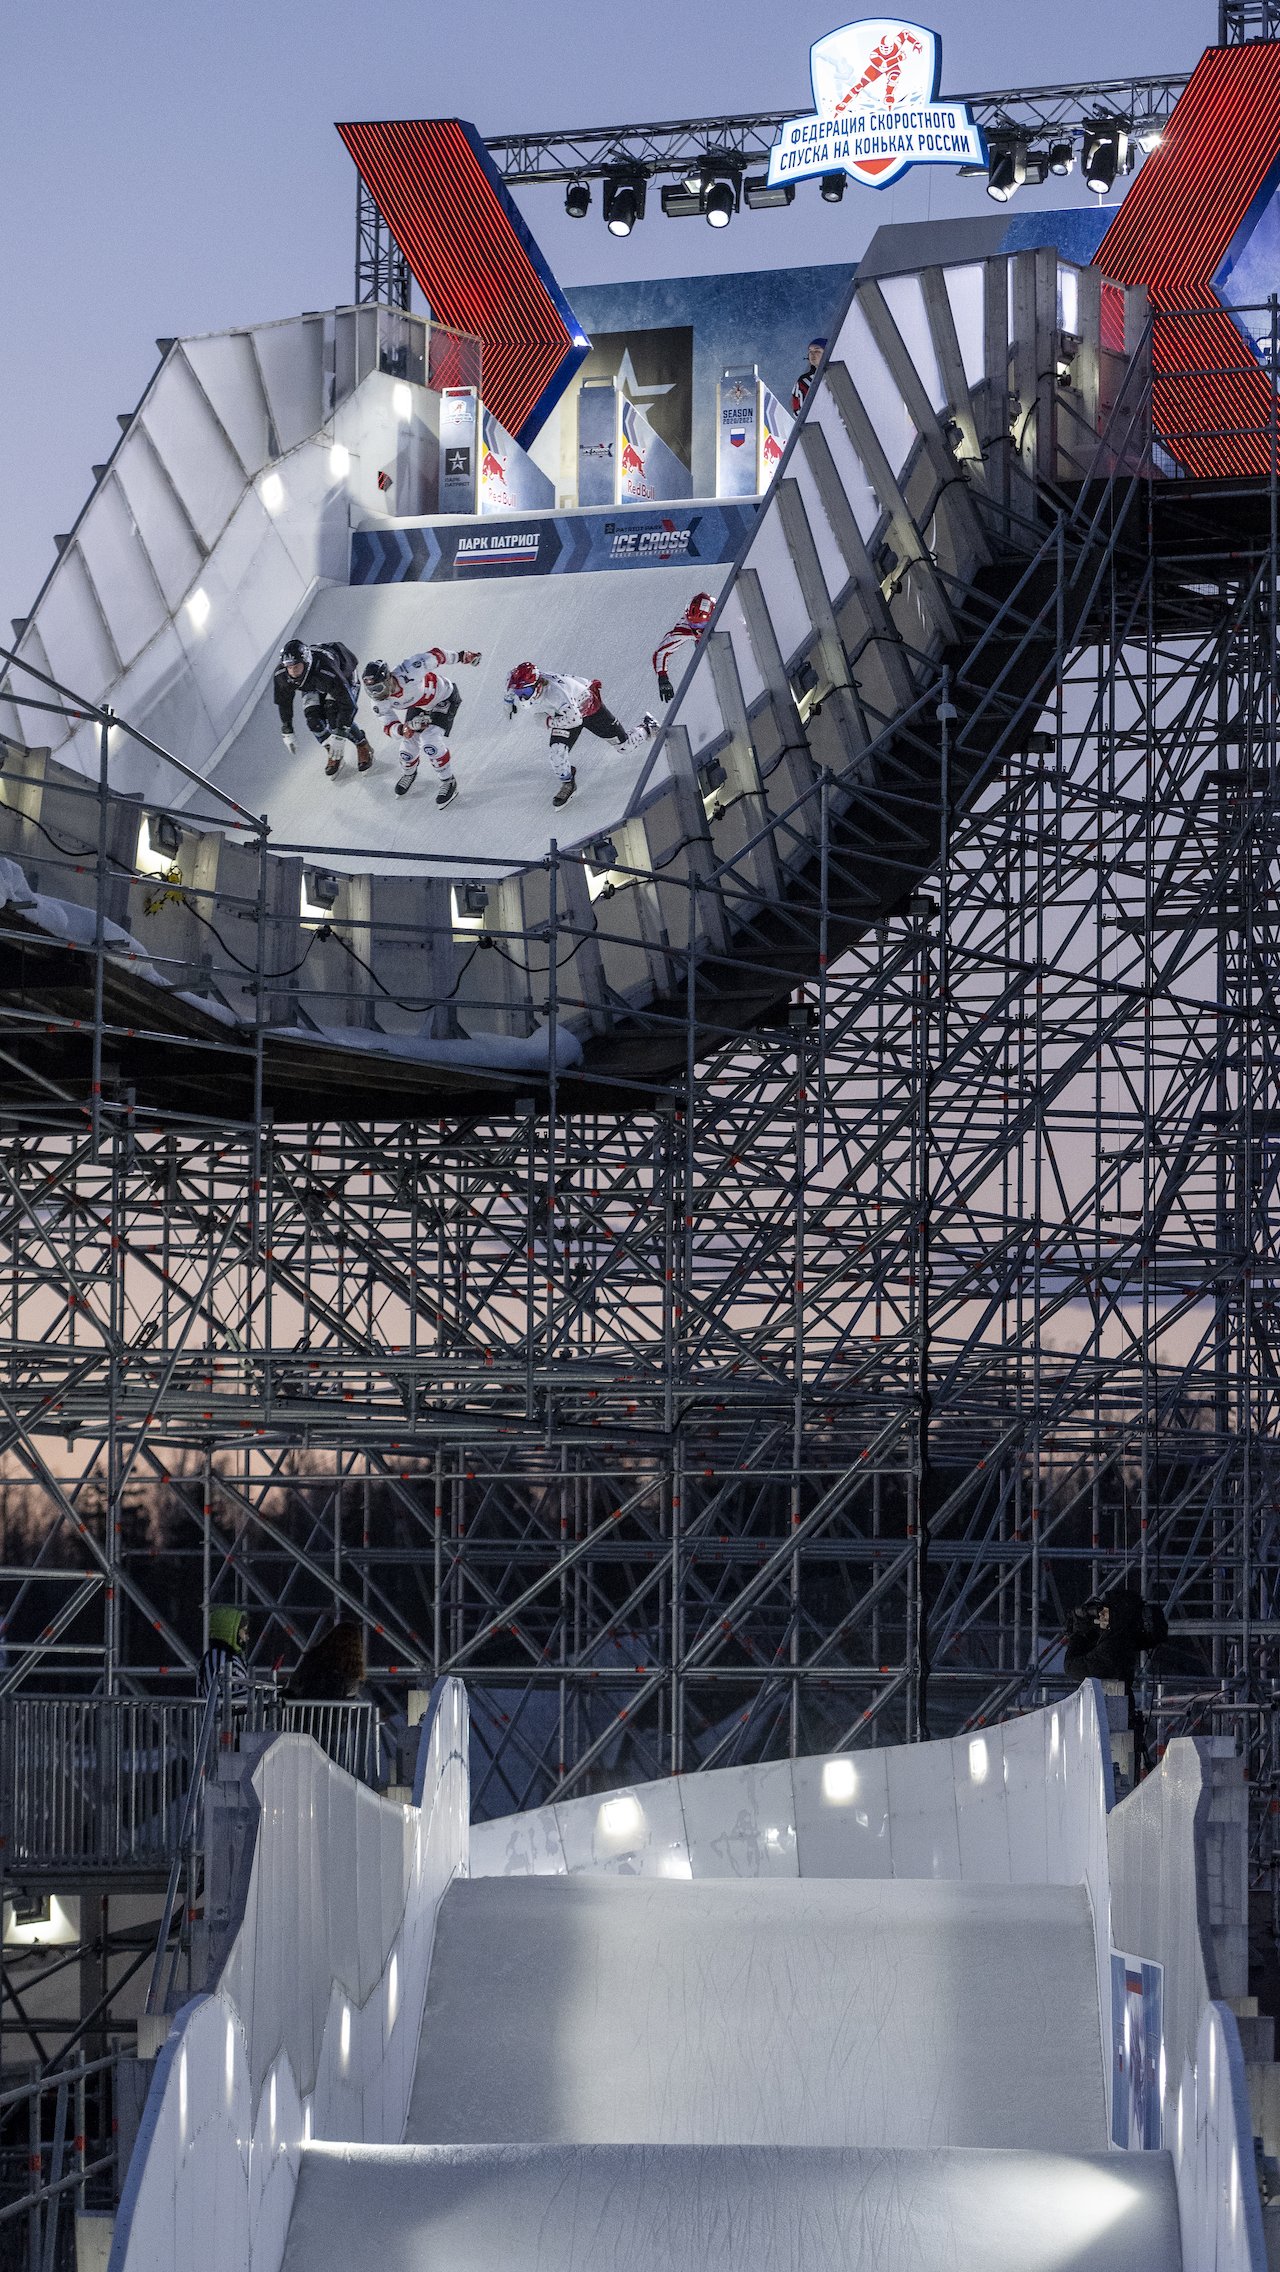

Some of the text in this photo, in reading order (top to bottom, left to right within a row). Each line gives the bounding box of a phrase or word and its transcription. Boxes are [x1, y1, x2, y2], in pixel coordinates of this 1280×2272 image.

[791, 112, 956, 144] ФЕДЕРАЦИЯ СКОРОСТНОГО
[780, 134, 970, 171] СПУСКА НА КОНЬКАХ РОССИИ
[722, 408, 754, 419] SEASON
[502, 492, 517, 508] Bull
[627, 480, 656, 500] Red Bull
[458, 533, 541, 551] ПАРК ПАТРИОТ
[611, 530, 691, 553] ICE CROSS
